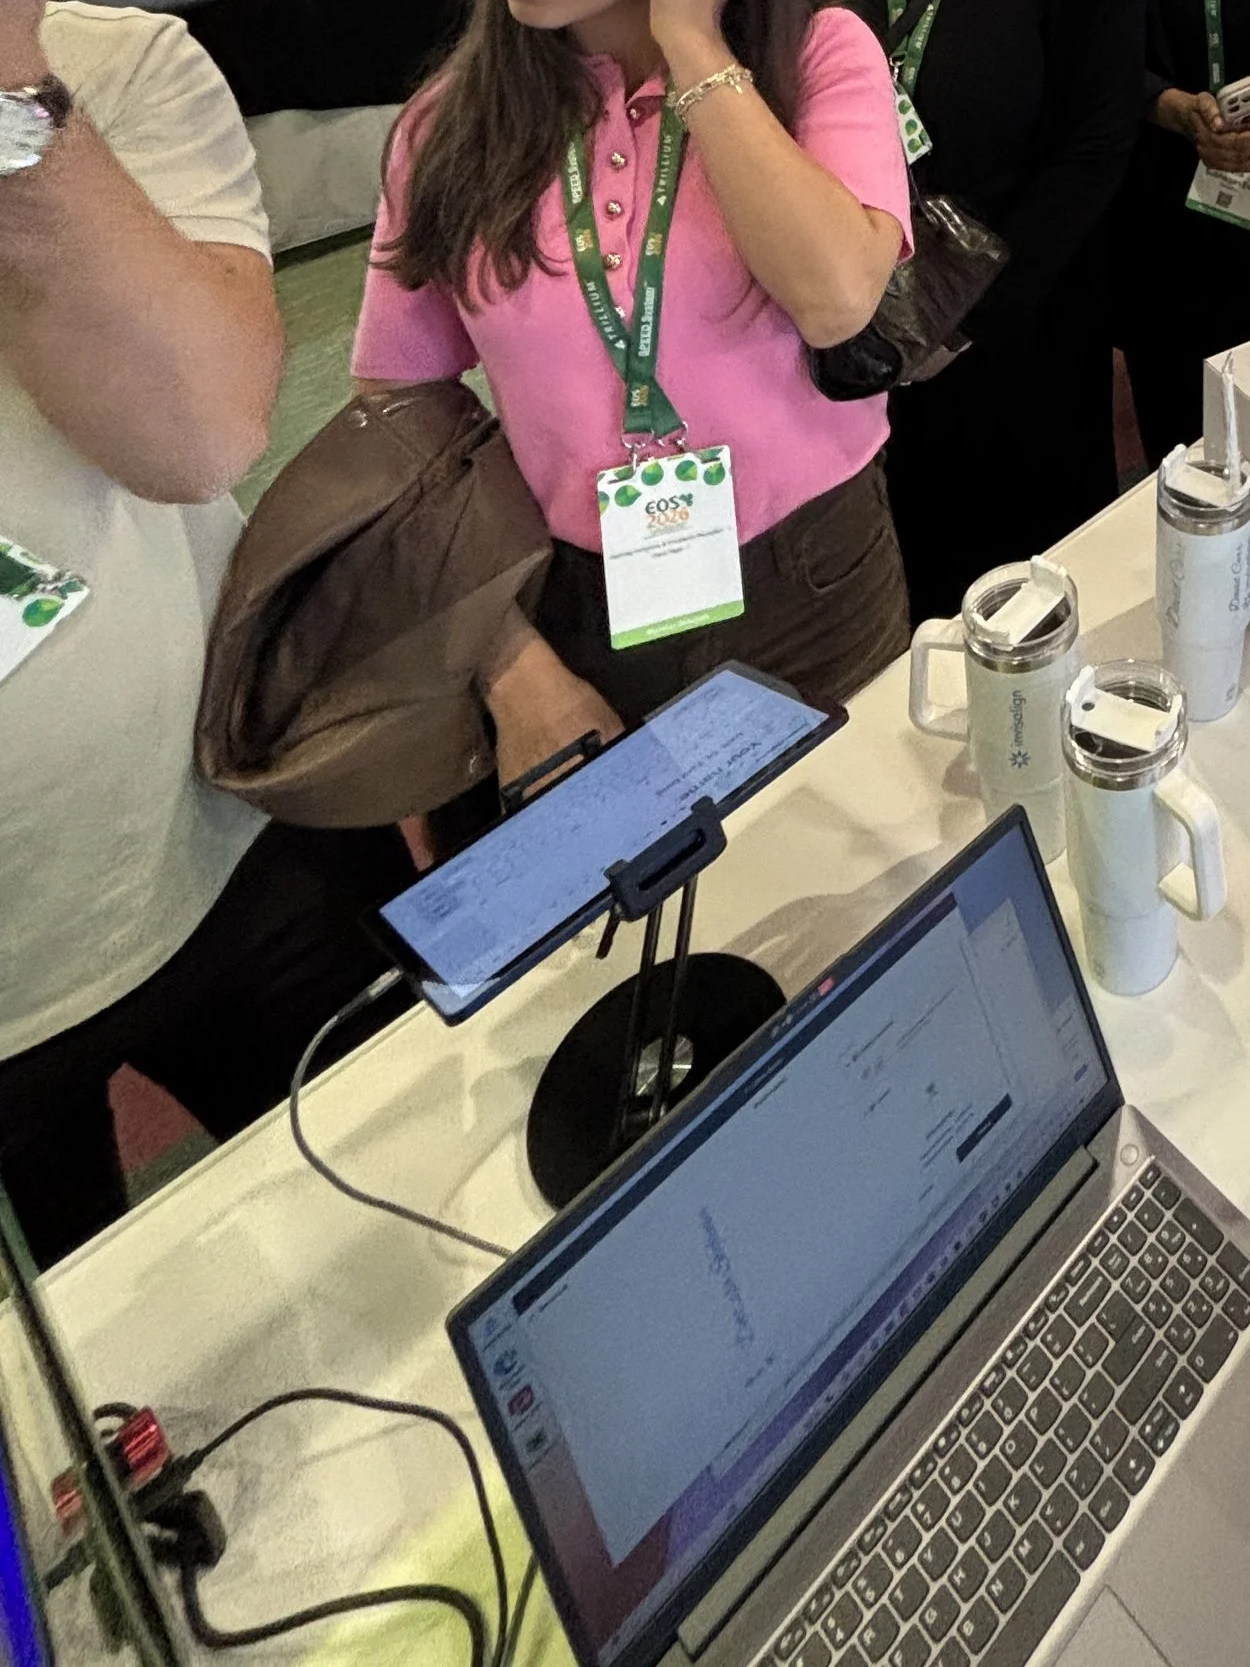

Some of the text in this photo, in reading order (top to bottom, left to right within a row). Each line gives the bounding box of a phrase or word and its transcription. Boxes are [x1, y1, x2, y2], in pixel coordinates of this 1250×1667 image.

[656, 134, 673, 195] TRILLIUM
[586, 281, 618, 340] TRILLIUM
[645, 496, 681, 515] EOS
[1012, 689, 1027, 746] invisalign
